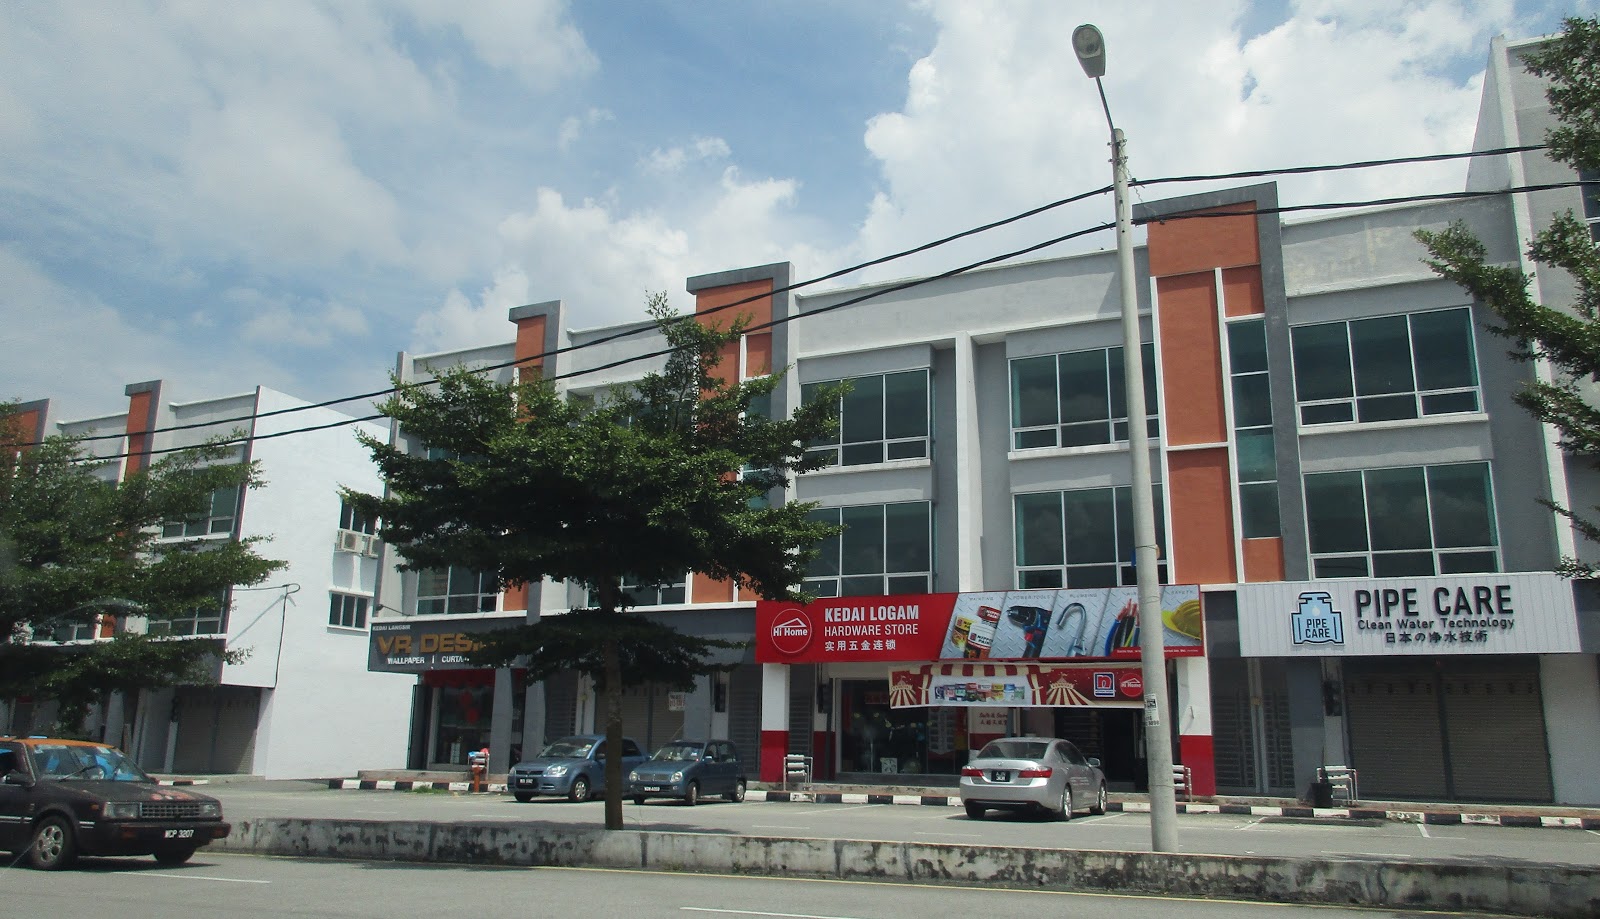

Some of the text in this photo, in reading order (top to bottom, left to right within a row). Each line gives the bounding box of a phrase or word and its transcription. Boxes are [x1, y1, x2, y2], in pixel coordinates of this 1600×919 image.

[1355, 585, 1514, 617] PIPE CARE
[824, 604, 919, 623] KEDAI LOGAM
[1306, 618, 1328, 628] PIPE
[1357, 617, 1515, 630] Clean Water Technology
[773, 627, 808, 637] Hi Home
[824, 623, 919, 637] HARDWARE STORE
[1305, 628, 1331, 638] CARE
[378, 632, 482, 655] VR DES
[824, 639, 897, 651] 实用五金连锁
[387, 655, 466, 665] WALLPAPER CURTA
[178, 829, 195, 838] 3207
